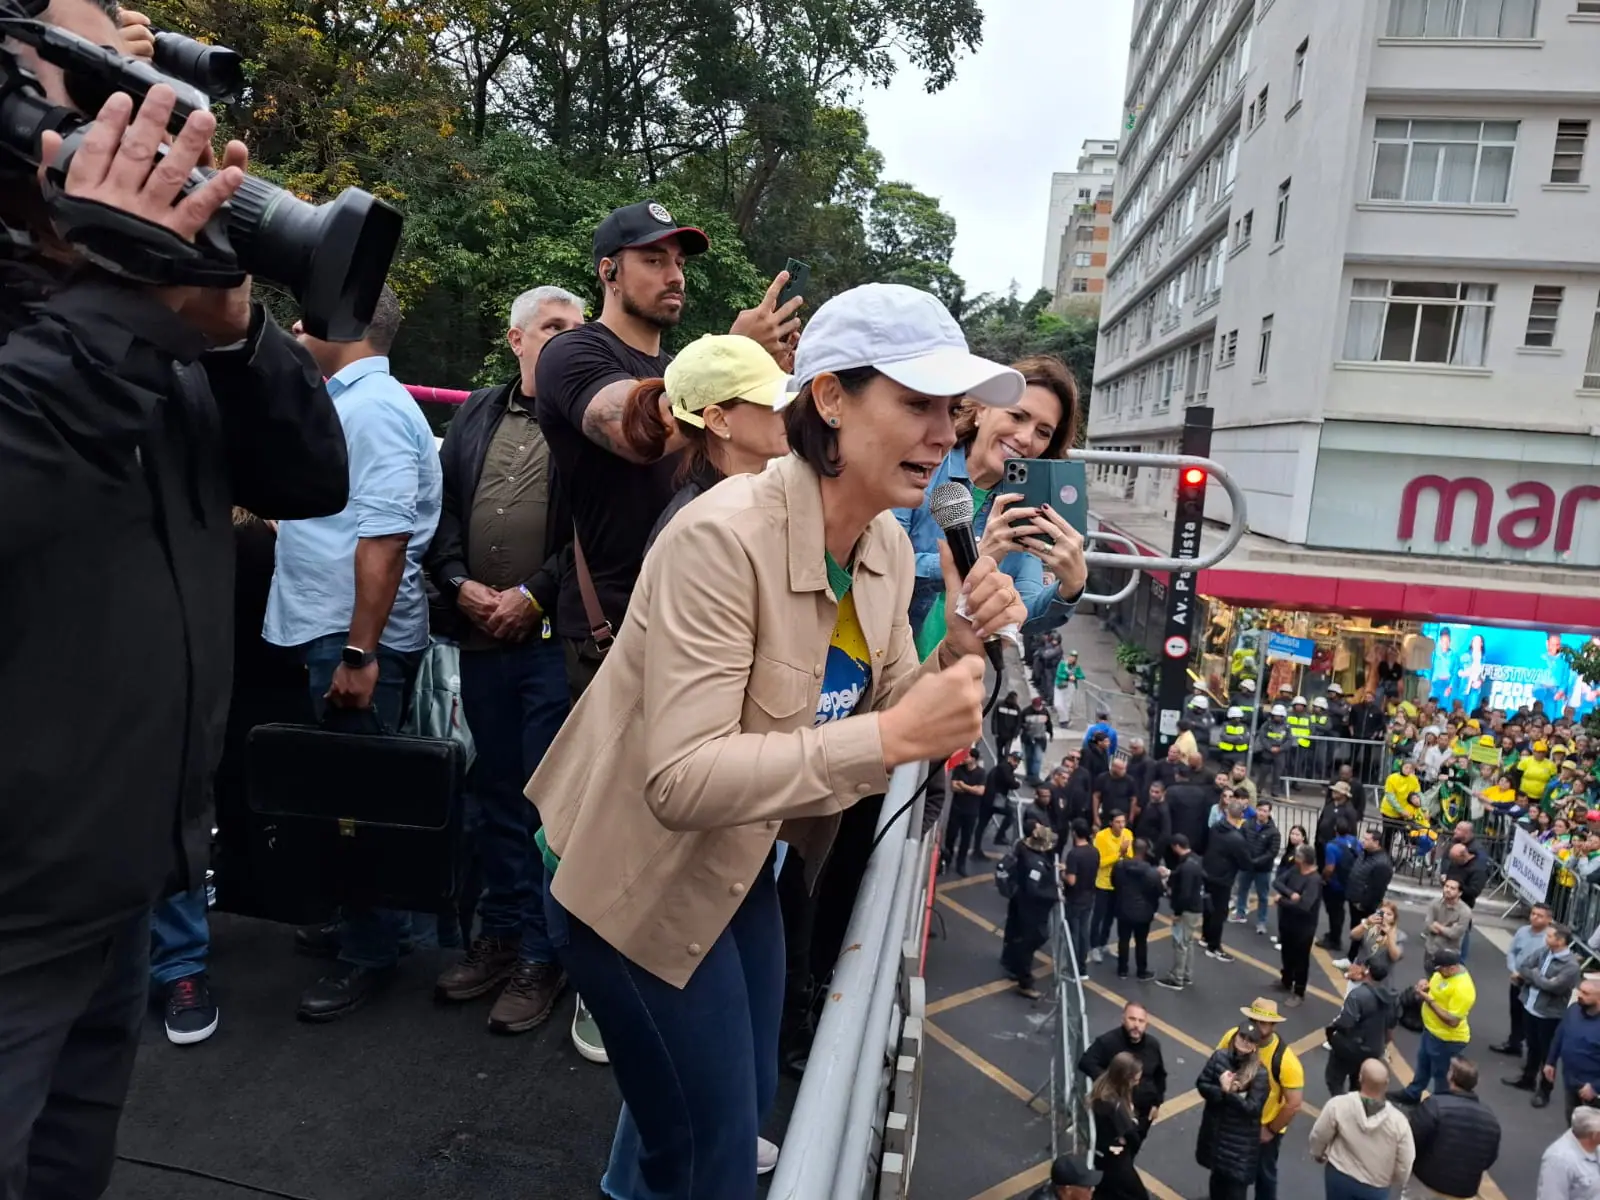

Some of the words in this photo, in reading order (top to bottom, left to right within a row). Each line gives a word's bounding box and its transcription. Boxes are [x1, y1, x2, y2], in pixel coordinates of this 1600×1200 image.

[1175, 522, 1196, 591] Palista
[1172, 597, 1188, 625] Av.
[1492, 681, 1534, 697] PEDE
